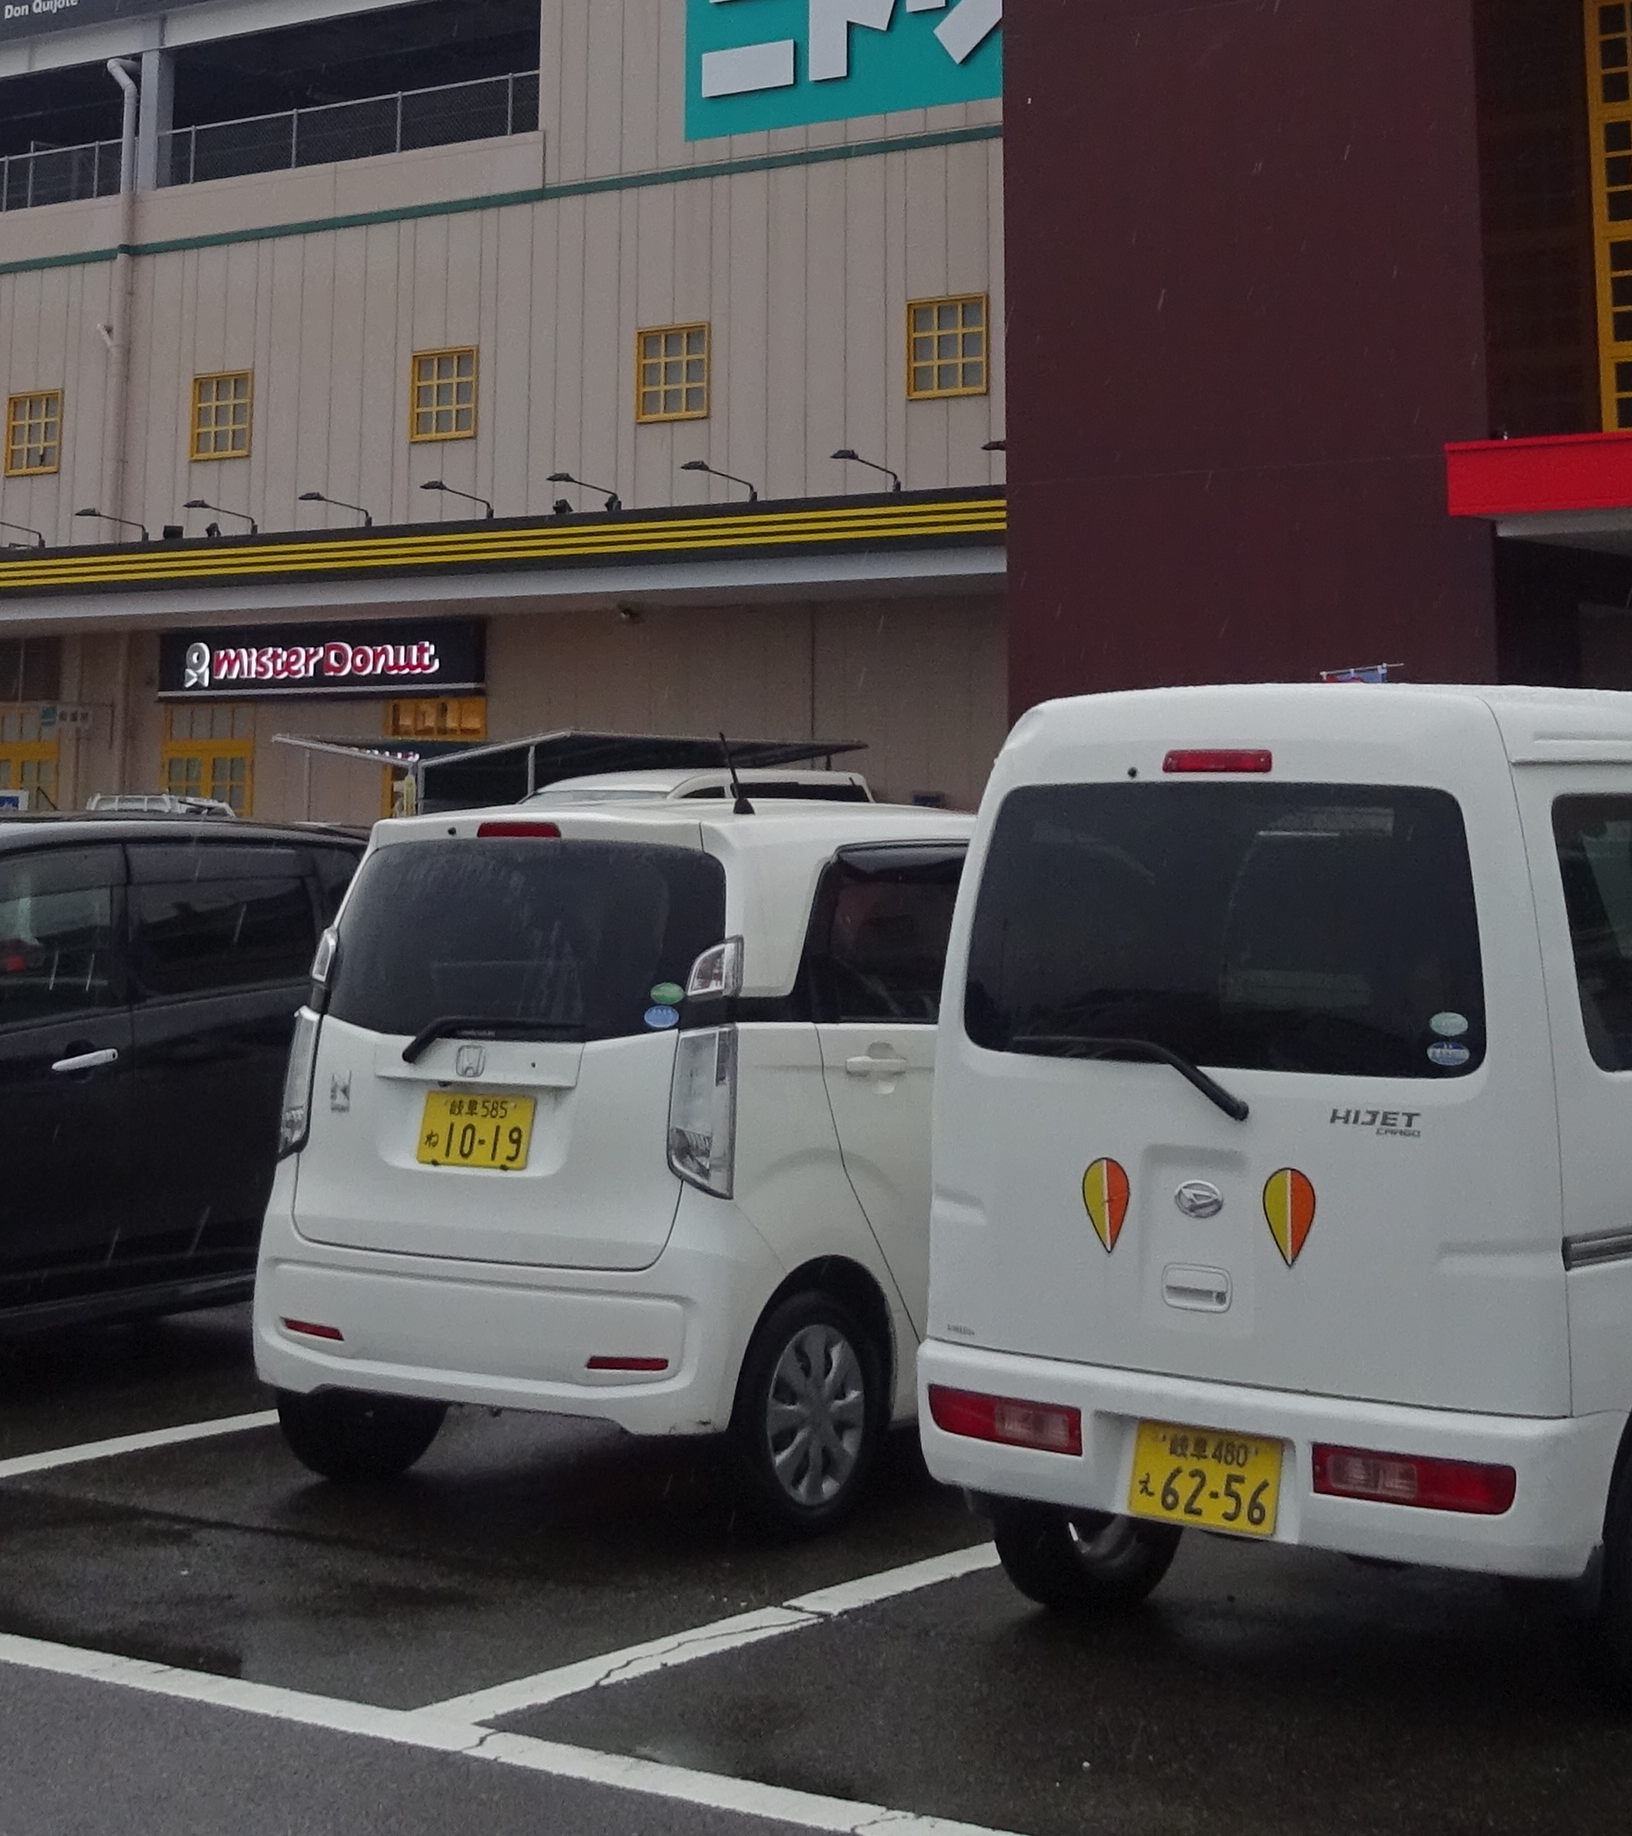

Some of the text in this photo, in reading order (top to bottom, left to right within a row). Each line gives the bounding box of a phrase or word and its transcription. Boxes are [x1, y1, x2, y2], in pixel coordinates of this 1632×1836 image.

[4, 3, 29, 19] Don
[323, 640, 439, 677] Donut
[1330, 1108, 1421, 1128] HIJET
[445, 1122, 522, 1162] 10-19
[1161, 1466, 1270, 1526] 62-56
